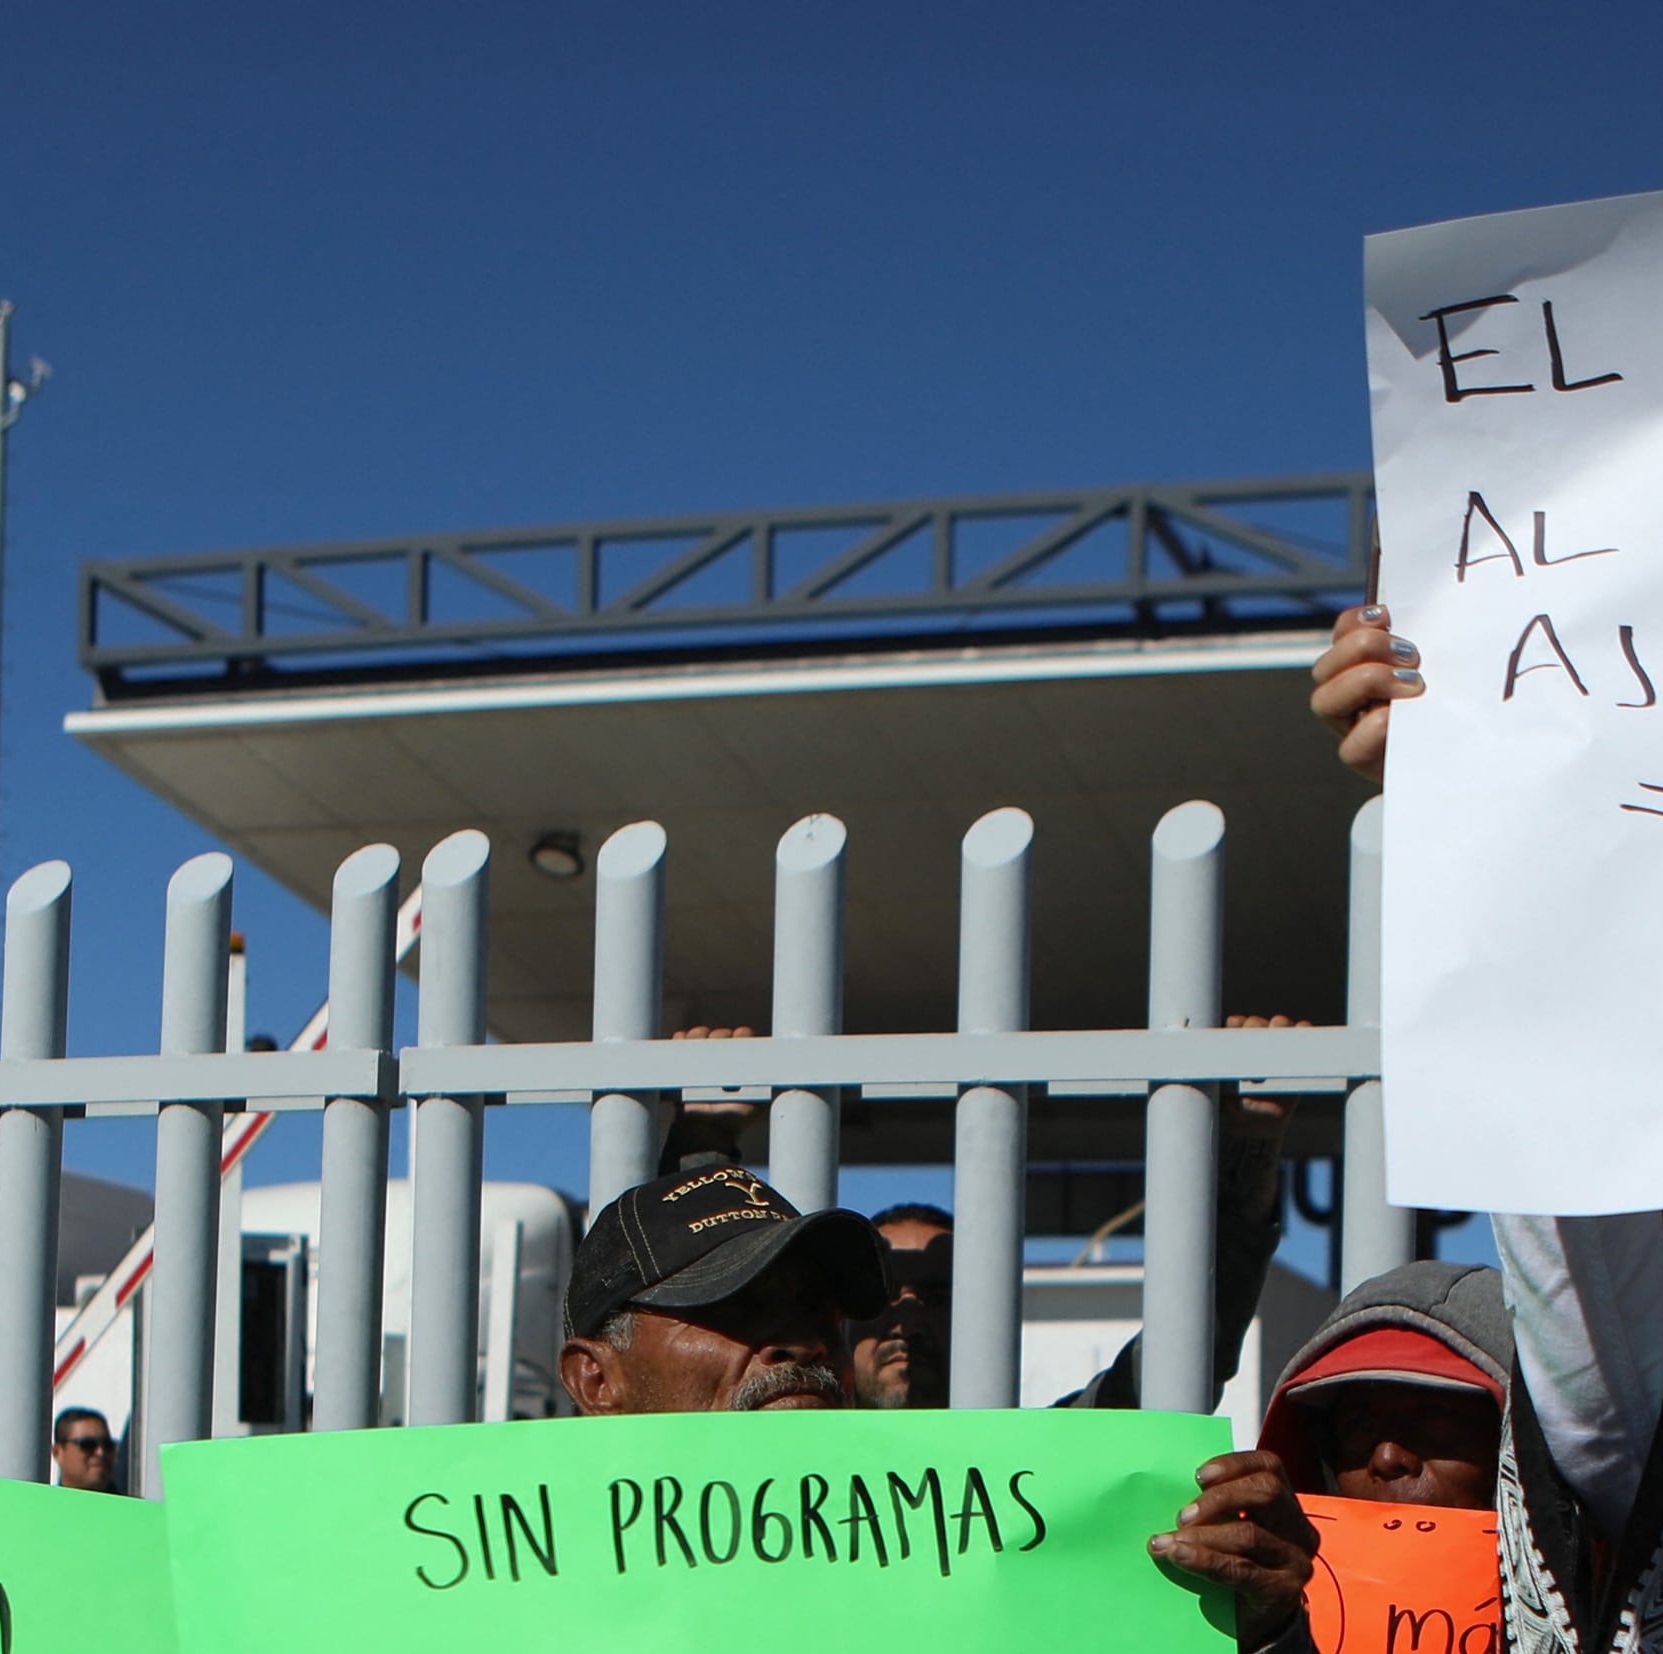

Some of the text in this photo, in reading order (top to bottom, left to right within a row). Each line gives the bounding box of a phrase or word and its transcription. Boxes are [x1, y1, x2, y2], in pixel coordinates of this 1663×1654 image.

[1419, 293, 1623, 404] EL
[1453, 490, 1620, 582] AL
[687, 1208, 768, 1235] DUTTON
[404, 1467, 1049, 1590] SIN PROGRAMAS
